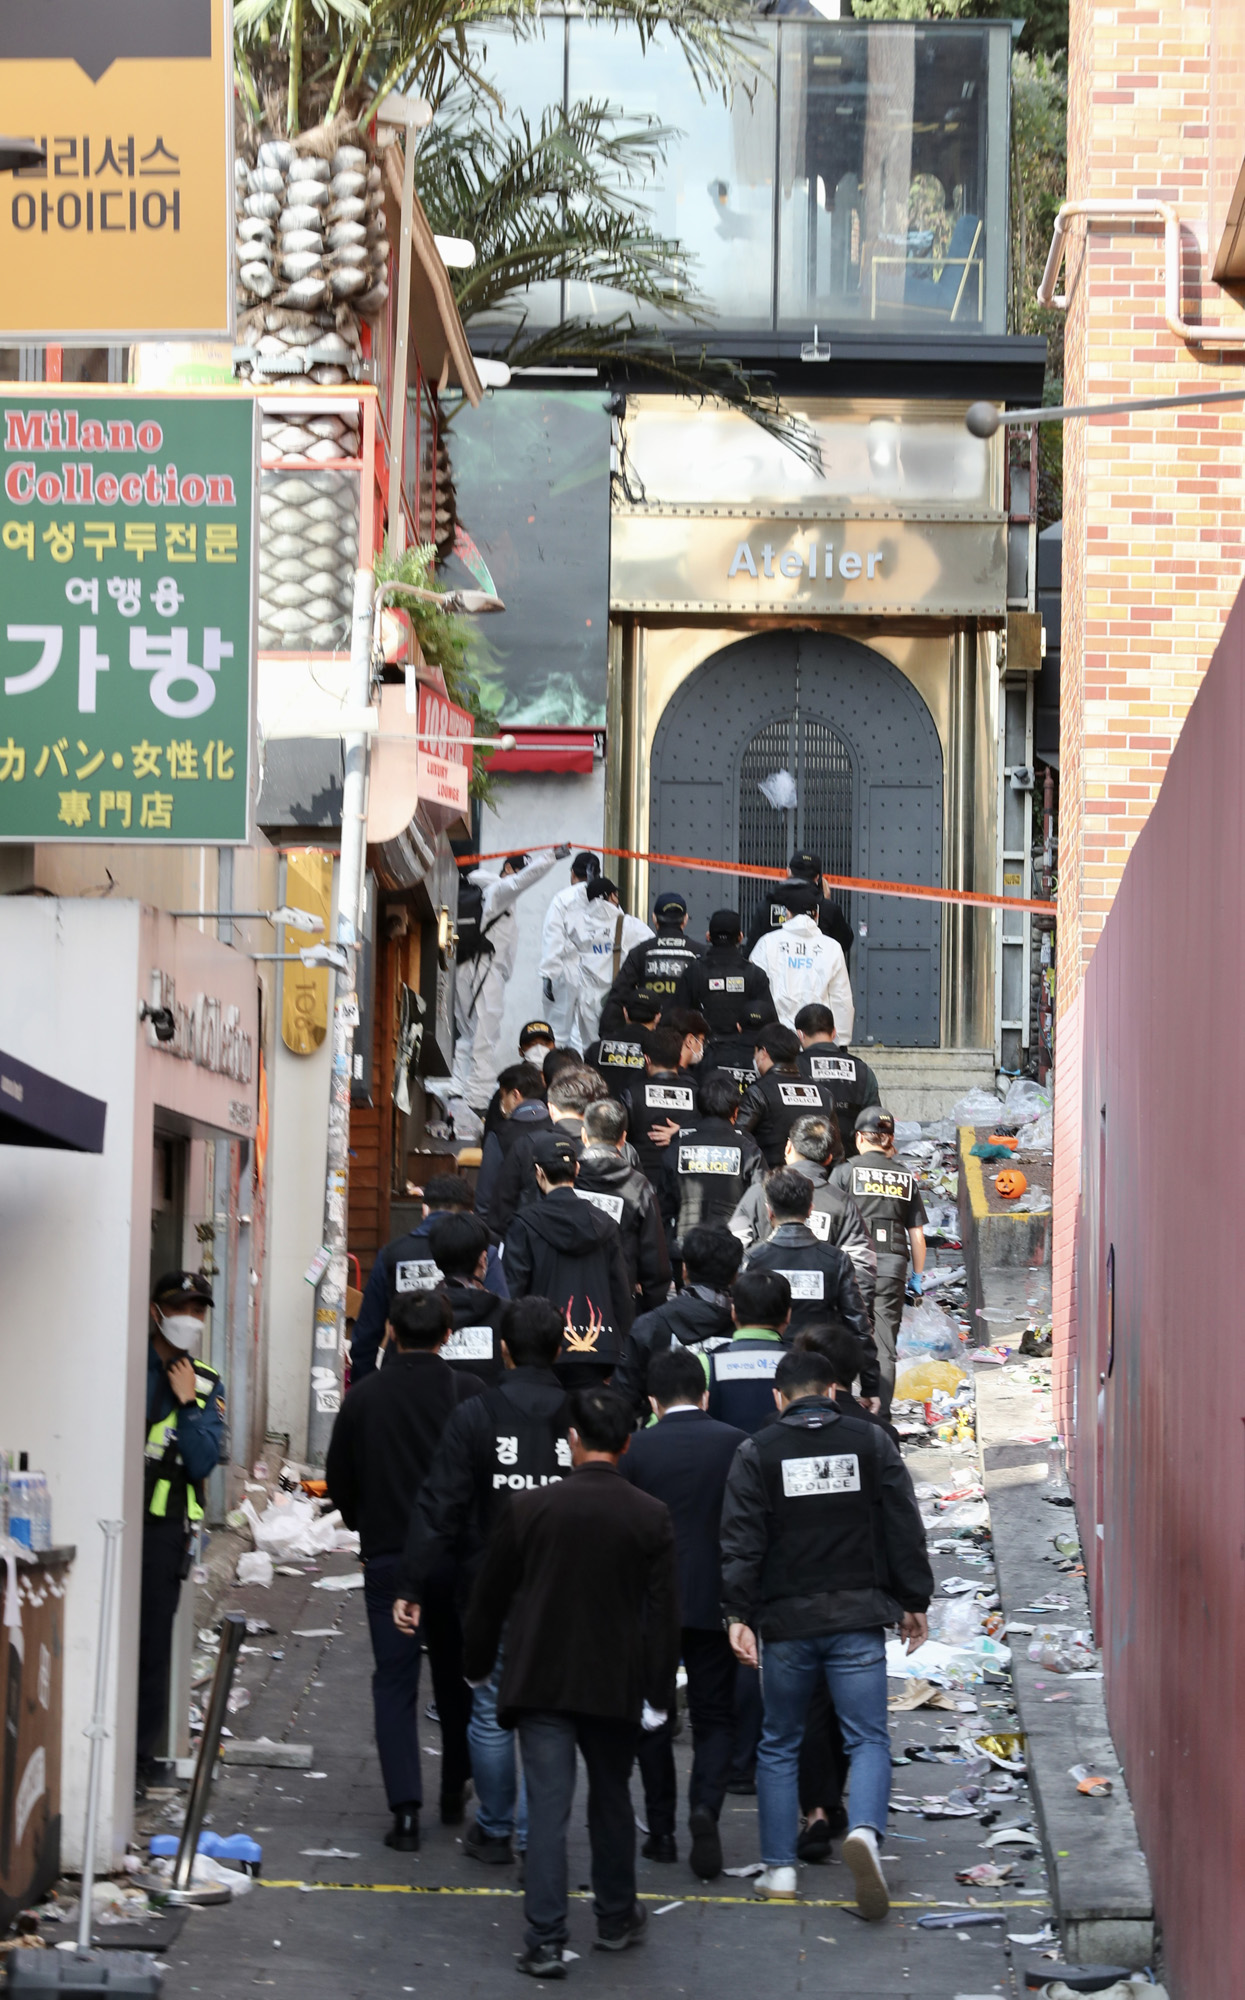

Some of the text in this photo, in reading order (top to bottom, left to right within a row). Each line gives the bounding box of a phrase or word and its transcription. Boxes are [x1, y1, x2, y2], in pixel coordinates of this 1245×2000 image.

[11, 189, 181, 233] 아이디어
[4, 409, 164, 453] Milano
[5, 461, 237, 507] Collection
[2, 520, 239, 564] 여성구두전문
[727, 541, 884, 580] Atelier
[65, 575, 185, 618] 여행용
[4, 624, 235, 719] 가방
[424, 694, 449, 760] 108
[427, 759, 449, 780] LUXURY
[437, 783, 460, 802] LOUNGE
[592, 943, 612, 955] NF
[647, 960, 689, 975] 과학수
[788, 956, 814, 969] NFS
[645, 981, 677, 994] POLI
[818, 1070, 851, 1078] POLICE
[786, 1096, 817, 1104] POLICE
[682, 1148, 738, 1162] 과학수사
[688, 1160, 729, 1172] POLICE
[857, 1169, 909, 1188] 과학수사
[864, 1182, 903, 1196] POLICE
[794, 1480, 852, 1492] POLICE
